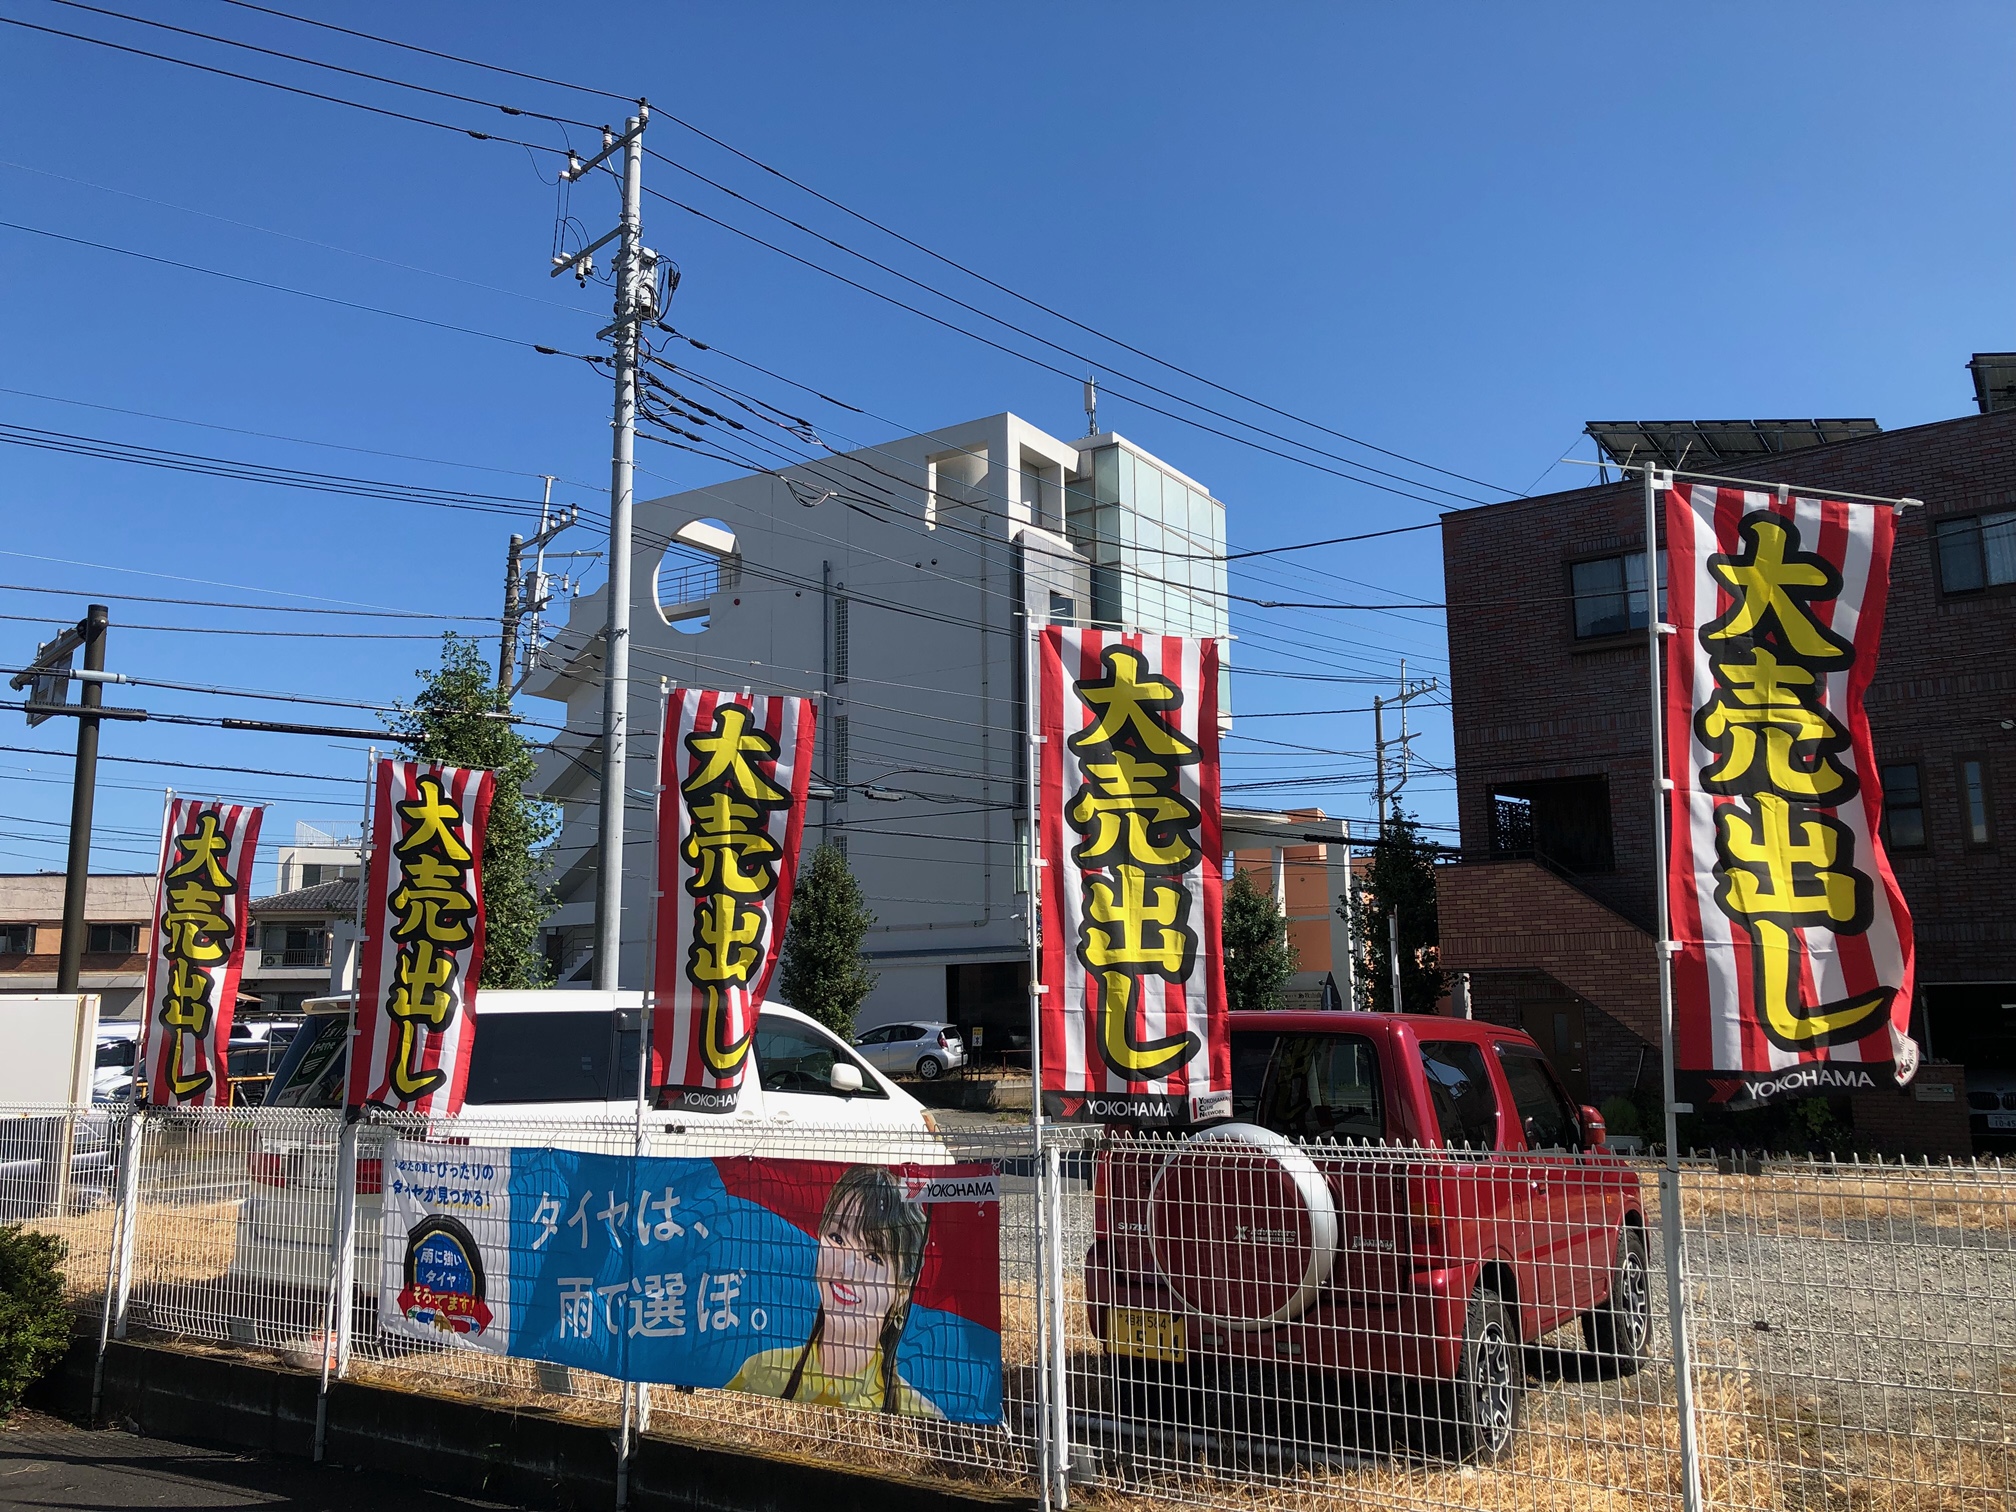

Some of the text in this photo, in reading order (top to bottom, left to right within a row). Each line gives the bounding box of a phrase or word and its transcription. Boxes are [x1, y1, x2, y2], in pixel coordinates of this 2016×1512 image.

[1694, 510, 1899, 1052] 大売出し
[1065, 643, 1202, 1082] 大売出し
[680, 702, 794, 1079] 大売出し
[386, 774, 477, 1101] 大売出し
[158, 810, 236, 1100] 大売出し
[683, 1092, 741, 1108] YOKOHAM
[1745, 1069, 1876, 1100] YOKOHAMA
[1087, 1099, 1174, 1117] YOKOHAMA
[927, 1182, 995, 1197] YOKOHAMA
[420, 1247, 462, 1267] 雨に強い
[426, 1270, 457, 1288] タイヤ
